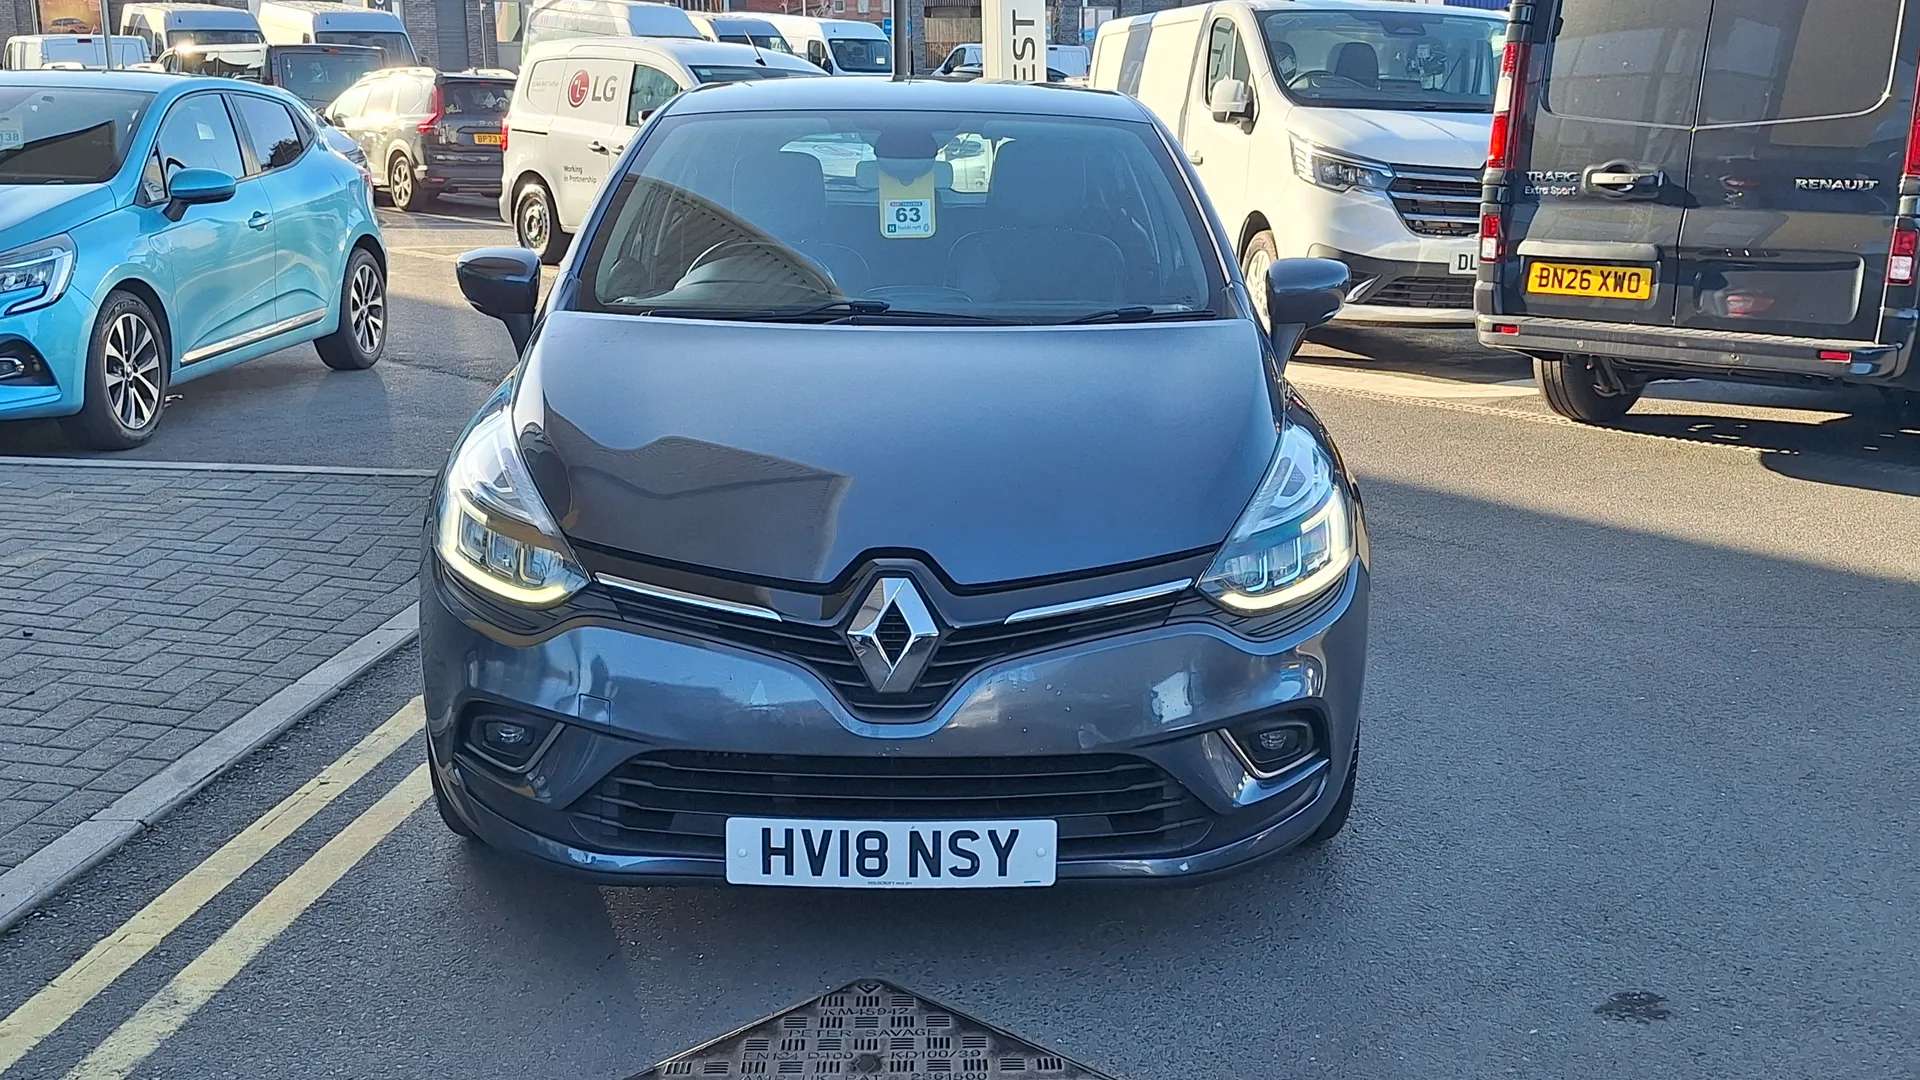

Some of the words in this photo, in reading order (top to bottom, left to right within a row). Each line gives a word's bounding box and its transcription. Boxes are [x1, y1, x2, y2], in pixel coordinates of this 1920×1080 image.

[592, 75, 618, 102] LG
[563, 165, 583, 175] Working
[1526, 171, 1580, 182] TRAFIC
[569, 175, 597, 184] Partnership
[1794, 178, 1879, 191] RENAULT
[1524, 186, 1548, 195] Extra
[1550, 186, 1576, 196] Sport
[895, 207, 921, 223] 63
[1458, 254, 1476, 270] DL
[1538, 267, 1592, 291] BN26
[1597, 271, 1641, 294] XWO
[761, 827, 889, 878] HV18
[908, 828, 1020, 878] NSY
[788, 1028, 853, 1038] PETER
[864, 1028, 939, 1038] SAVAGE
